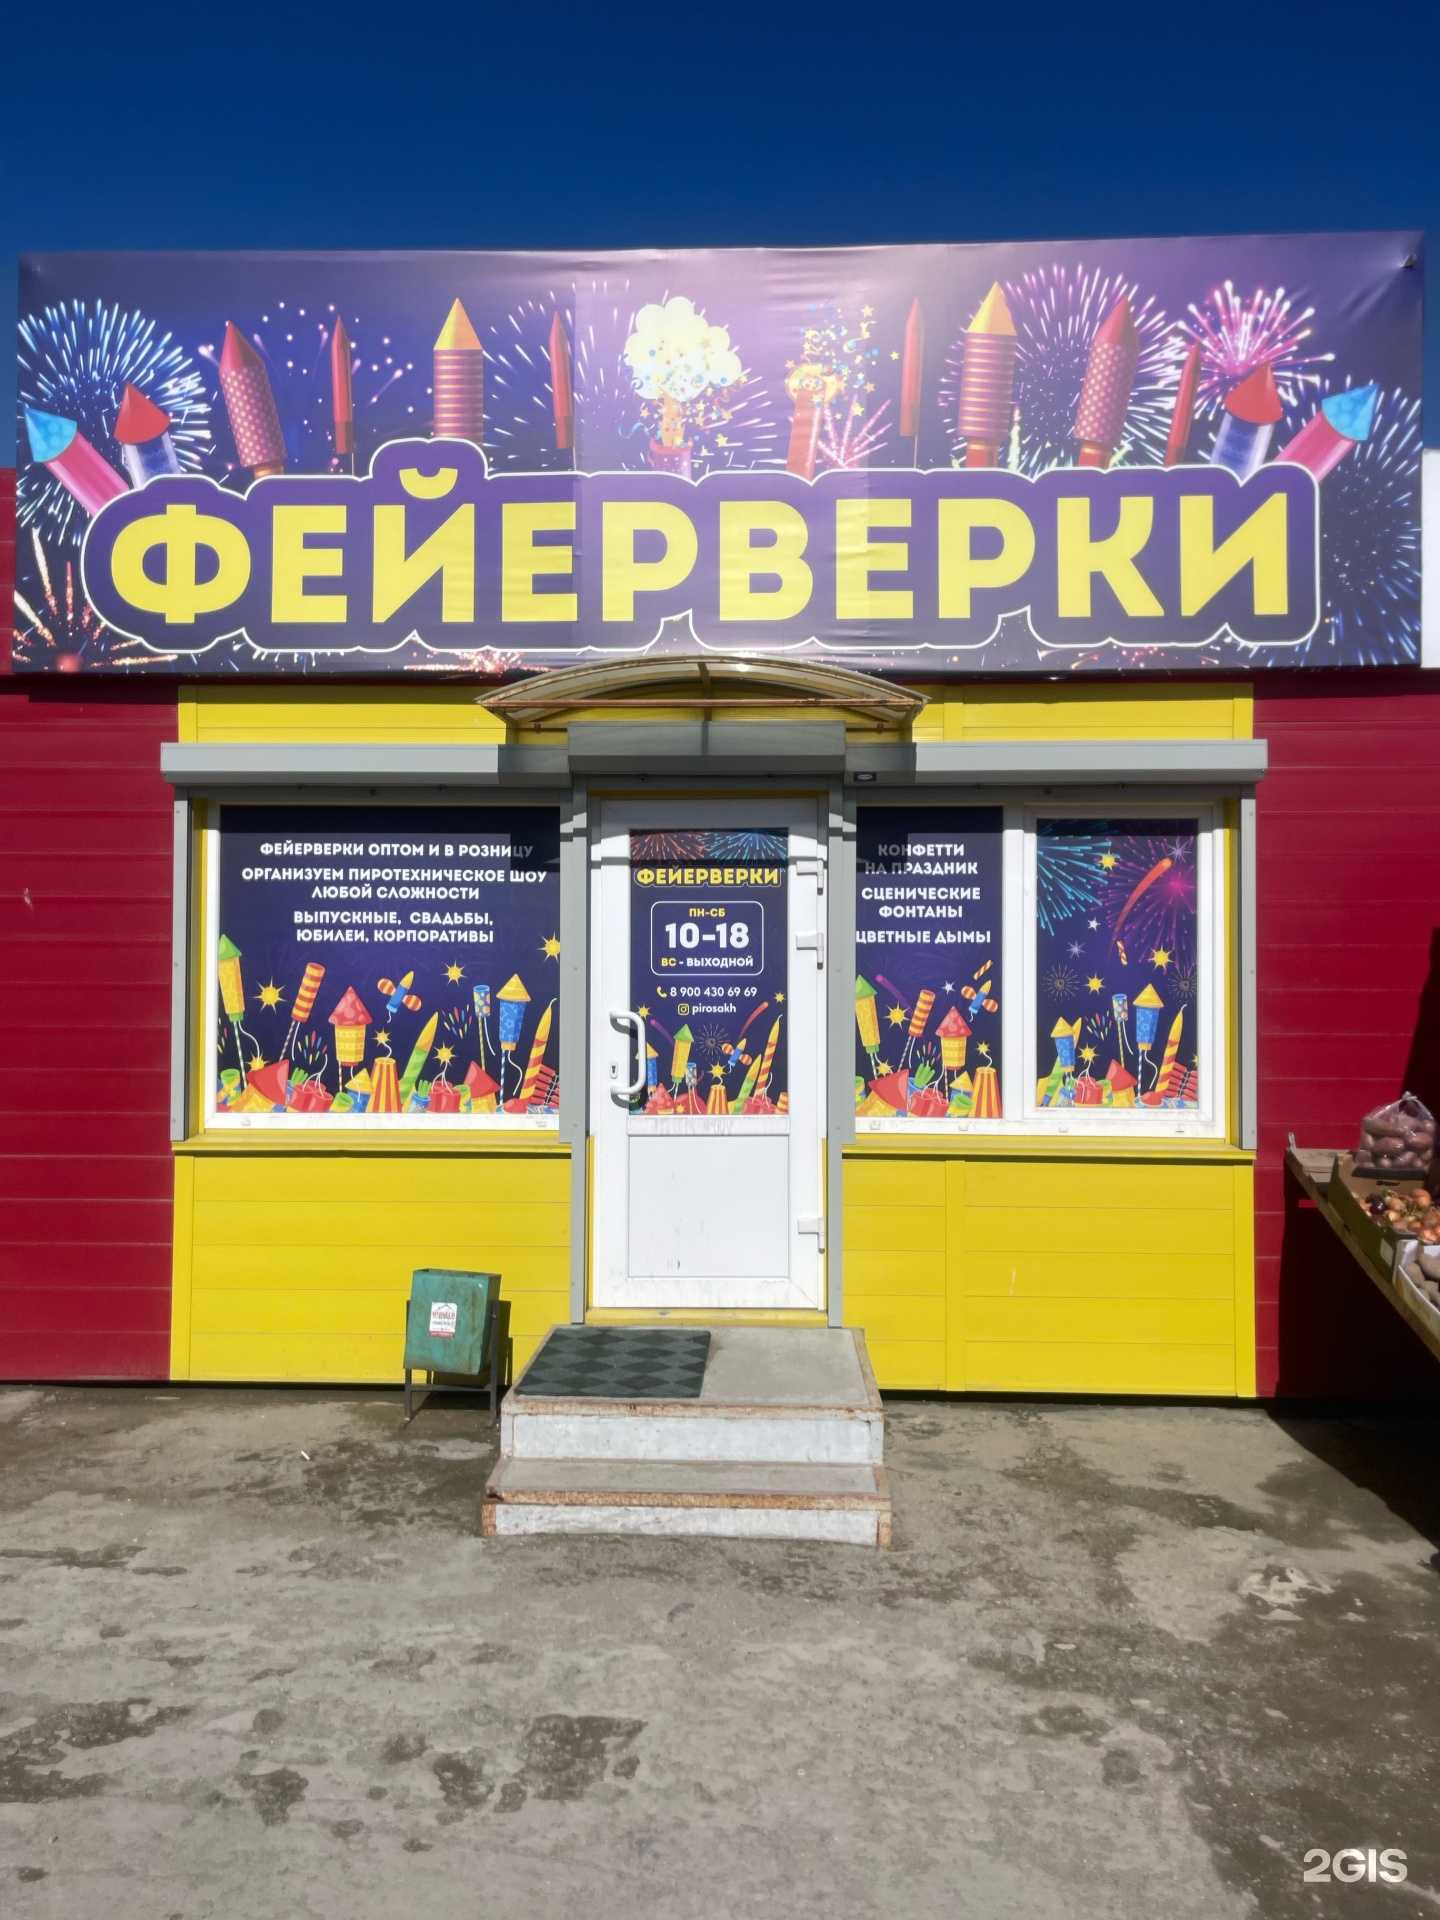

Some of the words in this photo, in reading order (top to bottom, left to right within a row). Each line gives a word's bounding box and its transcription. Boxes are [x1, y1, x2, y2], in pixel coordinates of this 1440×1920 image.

[110, 467, 1288, 624] ФЕЙЕРВЕРКИ
[260, 840, 364, 857] ФЕЙЕРВЕРКИ
[368, 844, 424, 857] ОПТОМ
[428, 845, 439, 857] И
[444, 845, 454, 857] В
[459, 844, 533, 859] РОЗНИЦУ
[878, 844, 965, 857] КОНФЕТТИ
[241, 867, 344, 881] ОРГАНИЗУЕМ
[349, 868, 505, 882] ПИРОТЕХНИЧЕСКОЕ
[509, 870, 547, 883] ШОУ
[636, 866, 779, 885] ФЕЙЕРВЕРКИ
[865, 862, 887, 875] НА
[892, 862, 978, 876] ПРАЗДНИК
[311, 884, 372, 900] ЛЮБОЙ
[376, 886, 480, 900] СЛОЖНОСТИ
[861, 887, 981, 901] СЦЕНИЧЕСКИЕ
[293, 911, 402, 925] ВЫПУСКНЫЕ,
[409, 912, 493, 926] СВАДЬБЫ,
[689, 908, 726, 918] ПН-СБ
[878, 905, 963, 918] ФОНТАНЫ
[296, 930, 369, 944] ЮБИЛЕИ,
[374, 930, 494, 943] КОРПОРАТИВЫ
[664, 922, 750, 949] 10-18
[856, 930, 931, 945] ЦВЕТНЫЕ
[934, 930, 991, 945] ДЫМЫ
[661, 957, 677, 967] ВС
[686, 955, 753, 968] ВЫХОДНОЙ
[669, 986, 678, 998] 8
[680, 986, 701, 998] 900
[704, 986, 725, 998] 430
[727, 986, 741, 998] 69
[743, 986, 758, 998] 69
[692, 1003, 737, 1015] pirosakh
